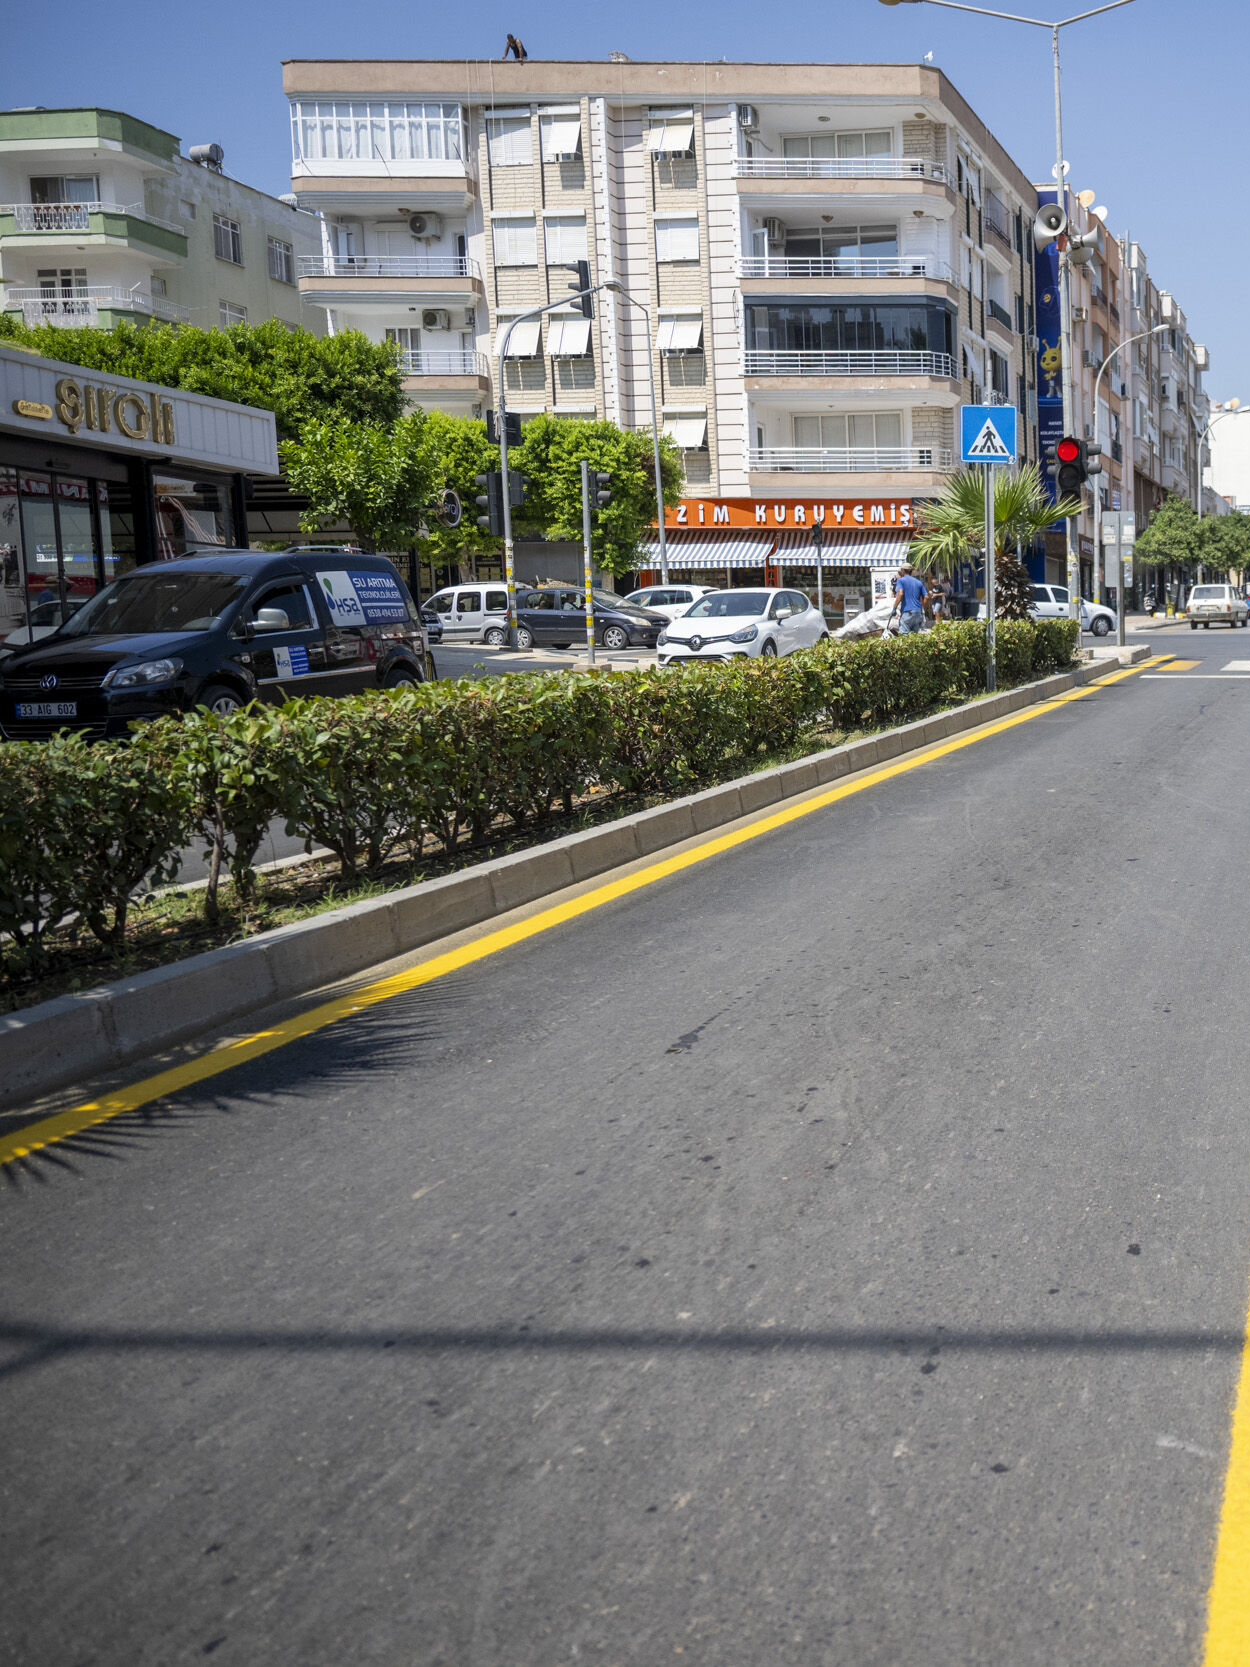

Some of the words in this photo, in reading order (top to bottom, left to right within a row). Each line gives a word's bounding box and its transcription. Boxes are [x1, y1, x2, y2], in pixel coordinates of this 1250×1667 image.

[676, 503, 730, 523] ZİM
[755, 502, 911, 526] KURUYEMİŞ
[352, 578, 365, 588] SU
[367, 578, 397, 588] ARITMA
[22, 704, 33, 716] 33
[38, 704, 52, 715] AIG
[57, 703, 75, 715] 602
